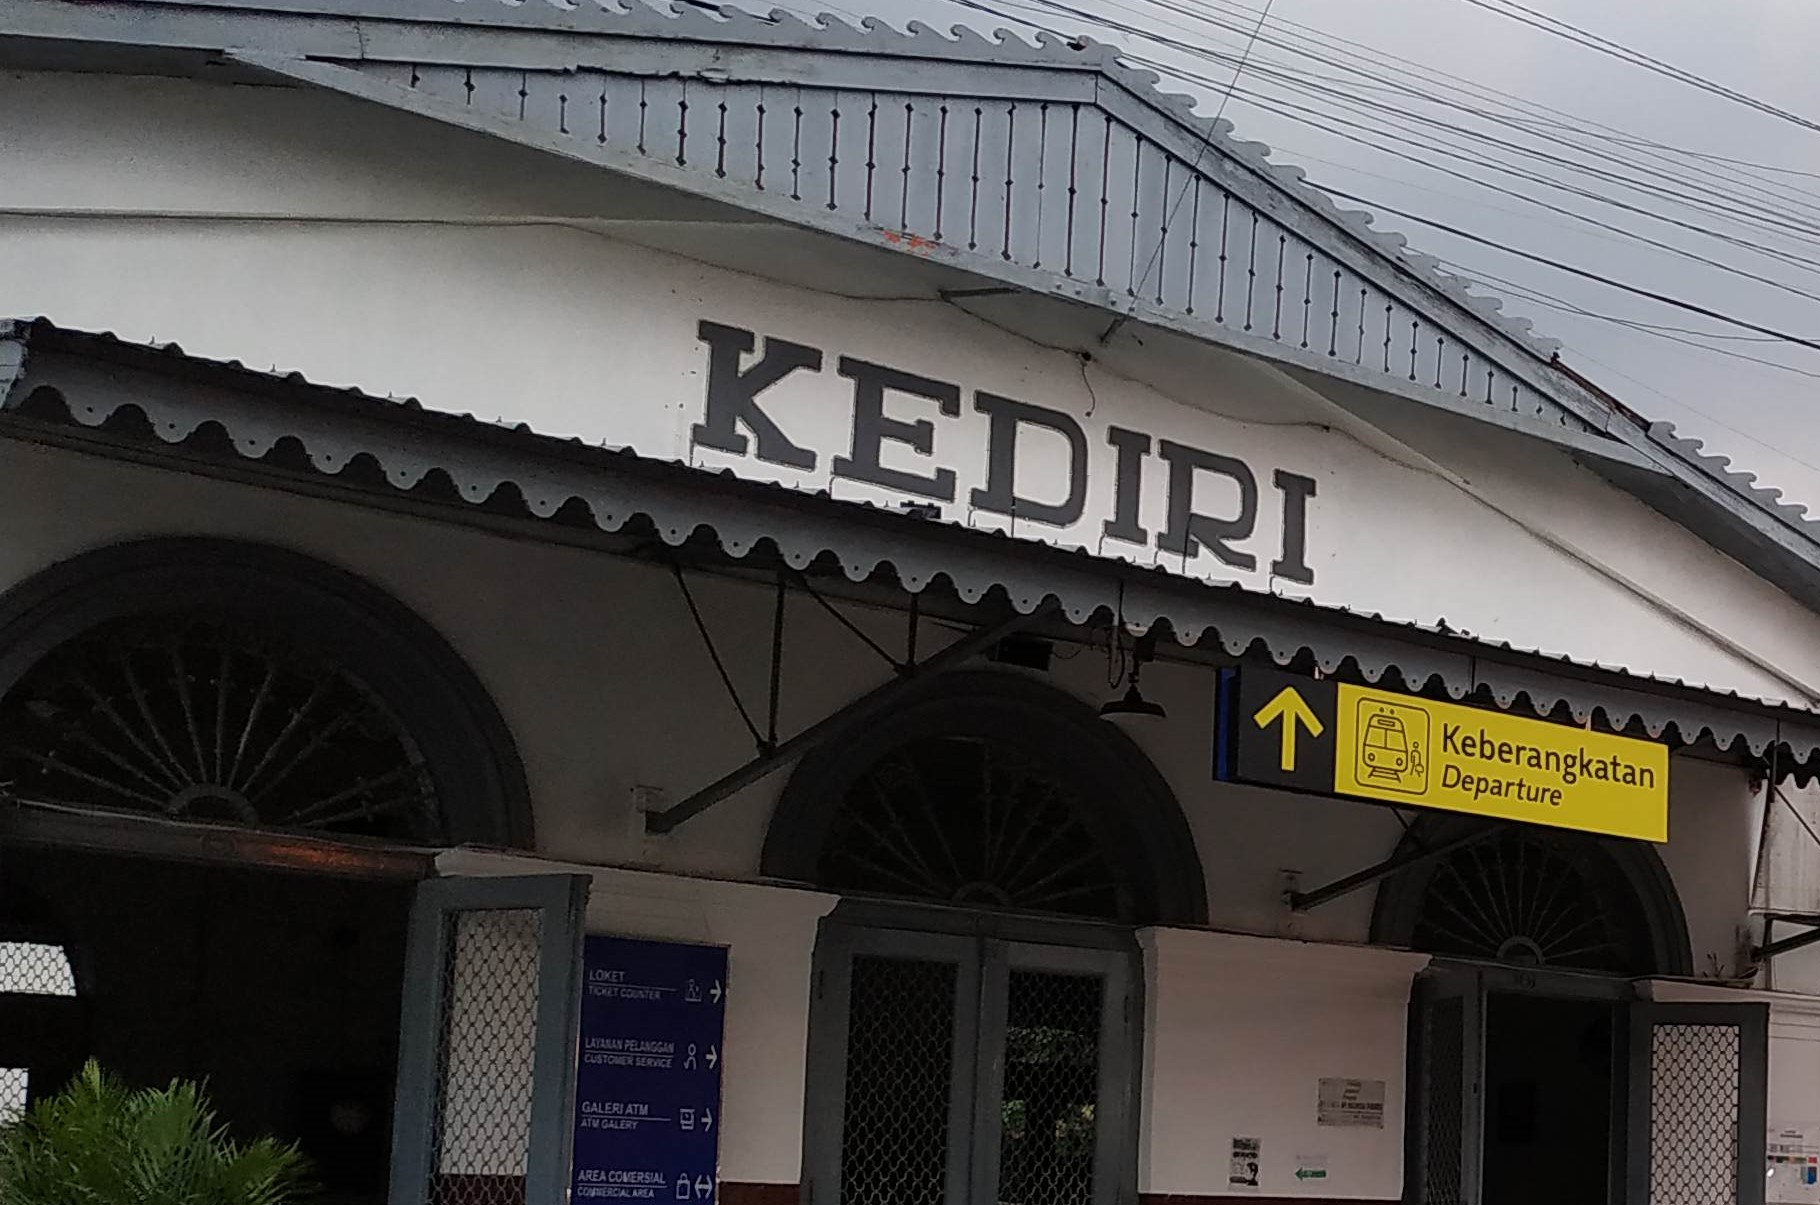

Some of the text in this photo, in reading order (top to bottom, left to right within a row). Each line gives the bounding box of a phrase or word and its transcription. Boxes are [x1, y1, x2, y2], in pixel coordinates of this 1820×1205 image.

[692, 320, 1317, 585] KEDIRI
[1441, 723, 1656, 789] Keberangkatan
[1441, 765, 1563, 806] Departure
[589, 969, 625, 983] LOKET
[587, 985, 662, 1000] TICKET COUNTER
[584, 1037, 675, 1054] LAYANAN PELANGGAN
[584, 1054, 673, 1069] CUSTOMER SERVICE
[581, 1101, 649, 1116] GALERI ATM
[580, 1116, 639, 1130] ATM GALERY
[577, 1169, 608, 1183] AREA
[631, 1188, 655, 1199] AREA
